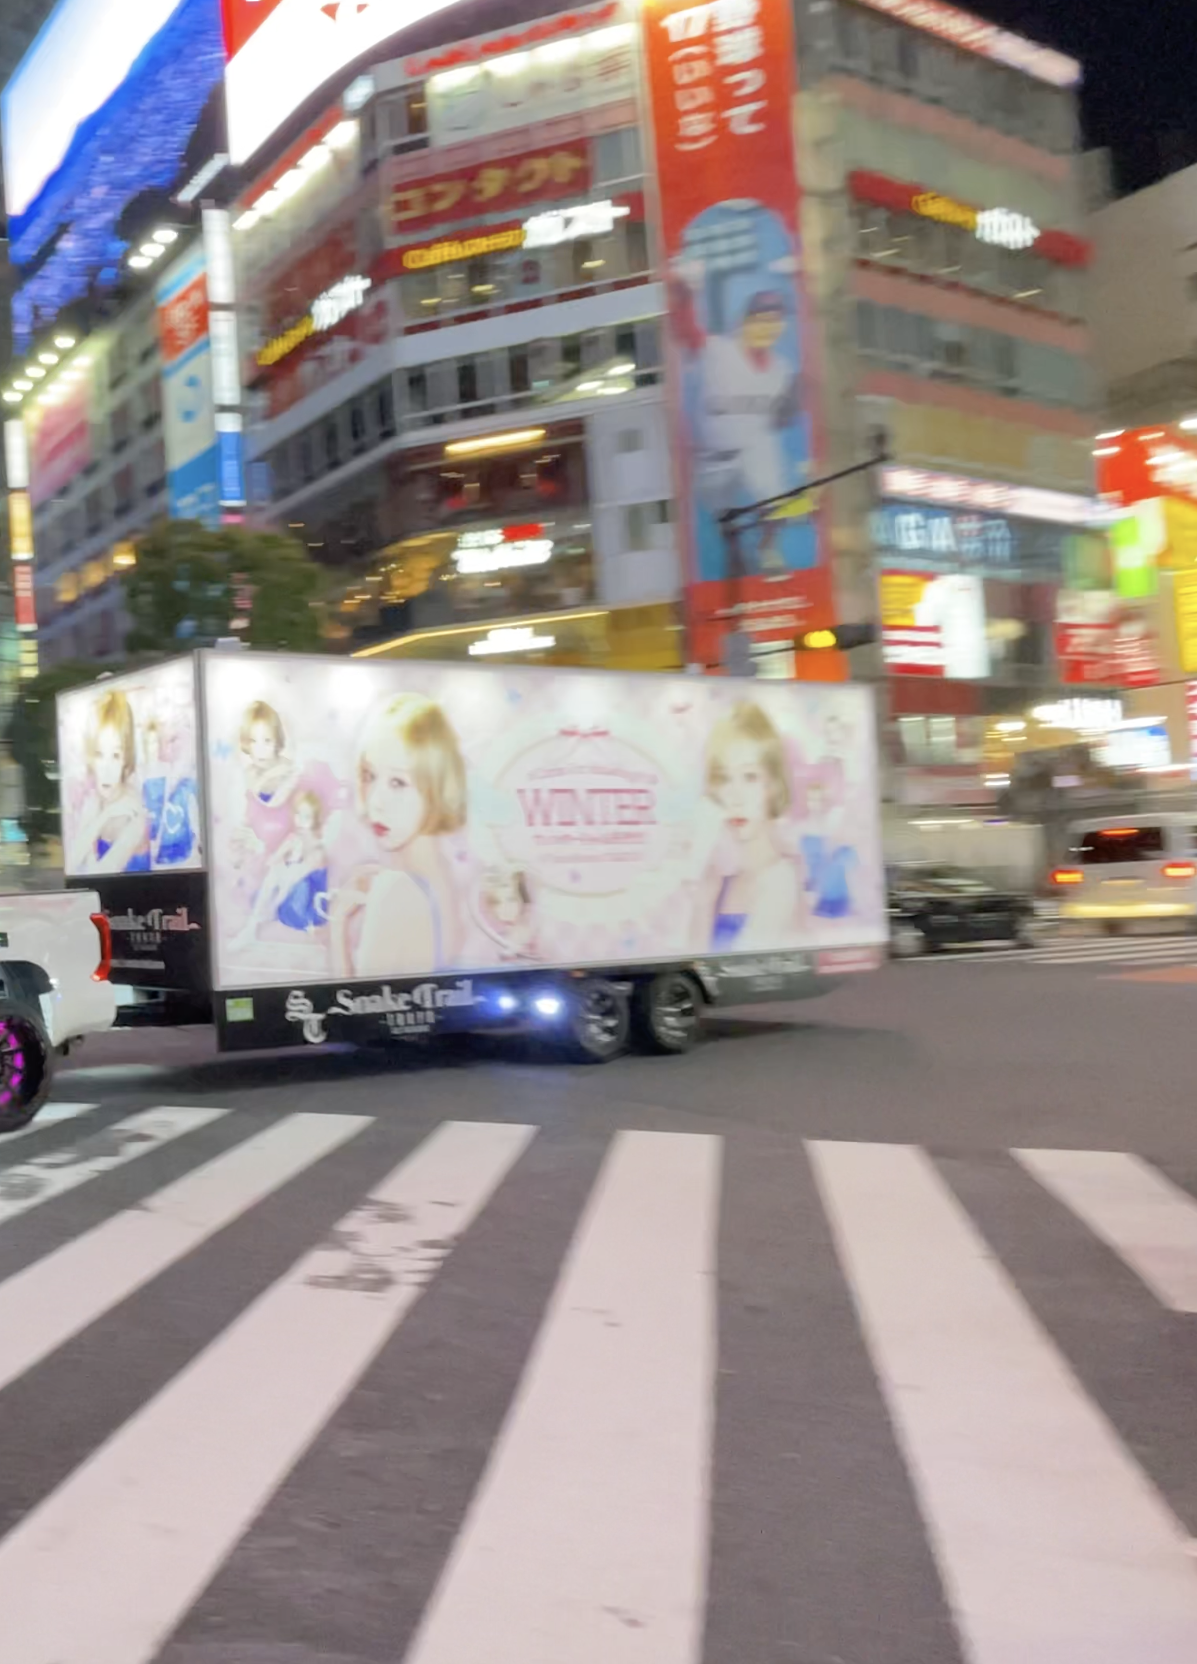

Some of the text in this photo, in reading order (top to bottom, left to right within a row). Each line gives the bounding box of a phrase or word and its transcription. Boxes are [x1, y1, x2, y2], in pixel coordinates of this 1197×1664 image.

[516, 788, 659, 827] WINTER
[327, 979, 487, 1016] Snake Trail
